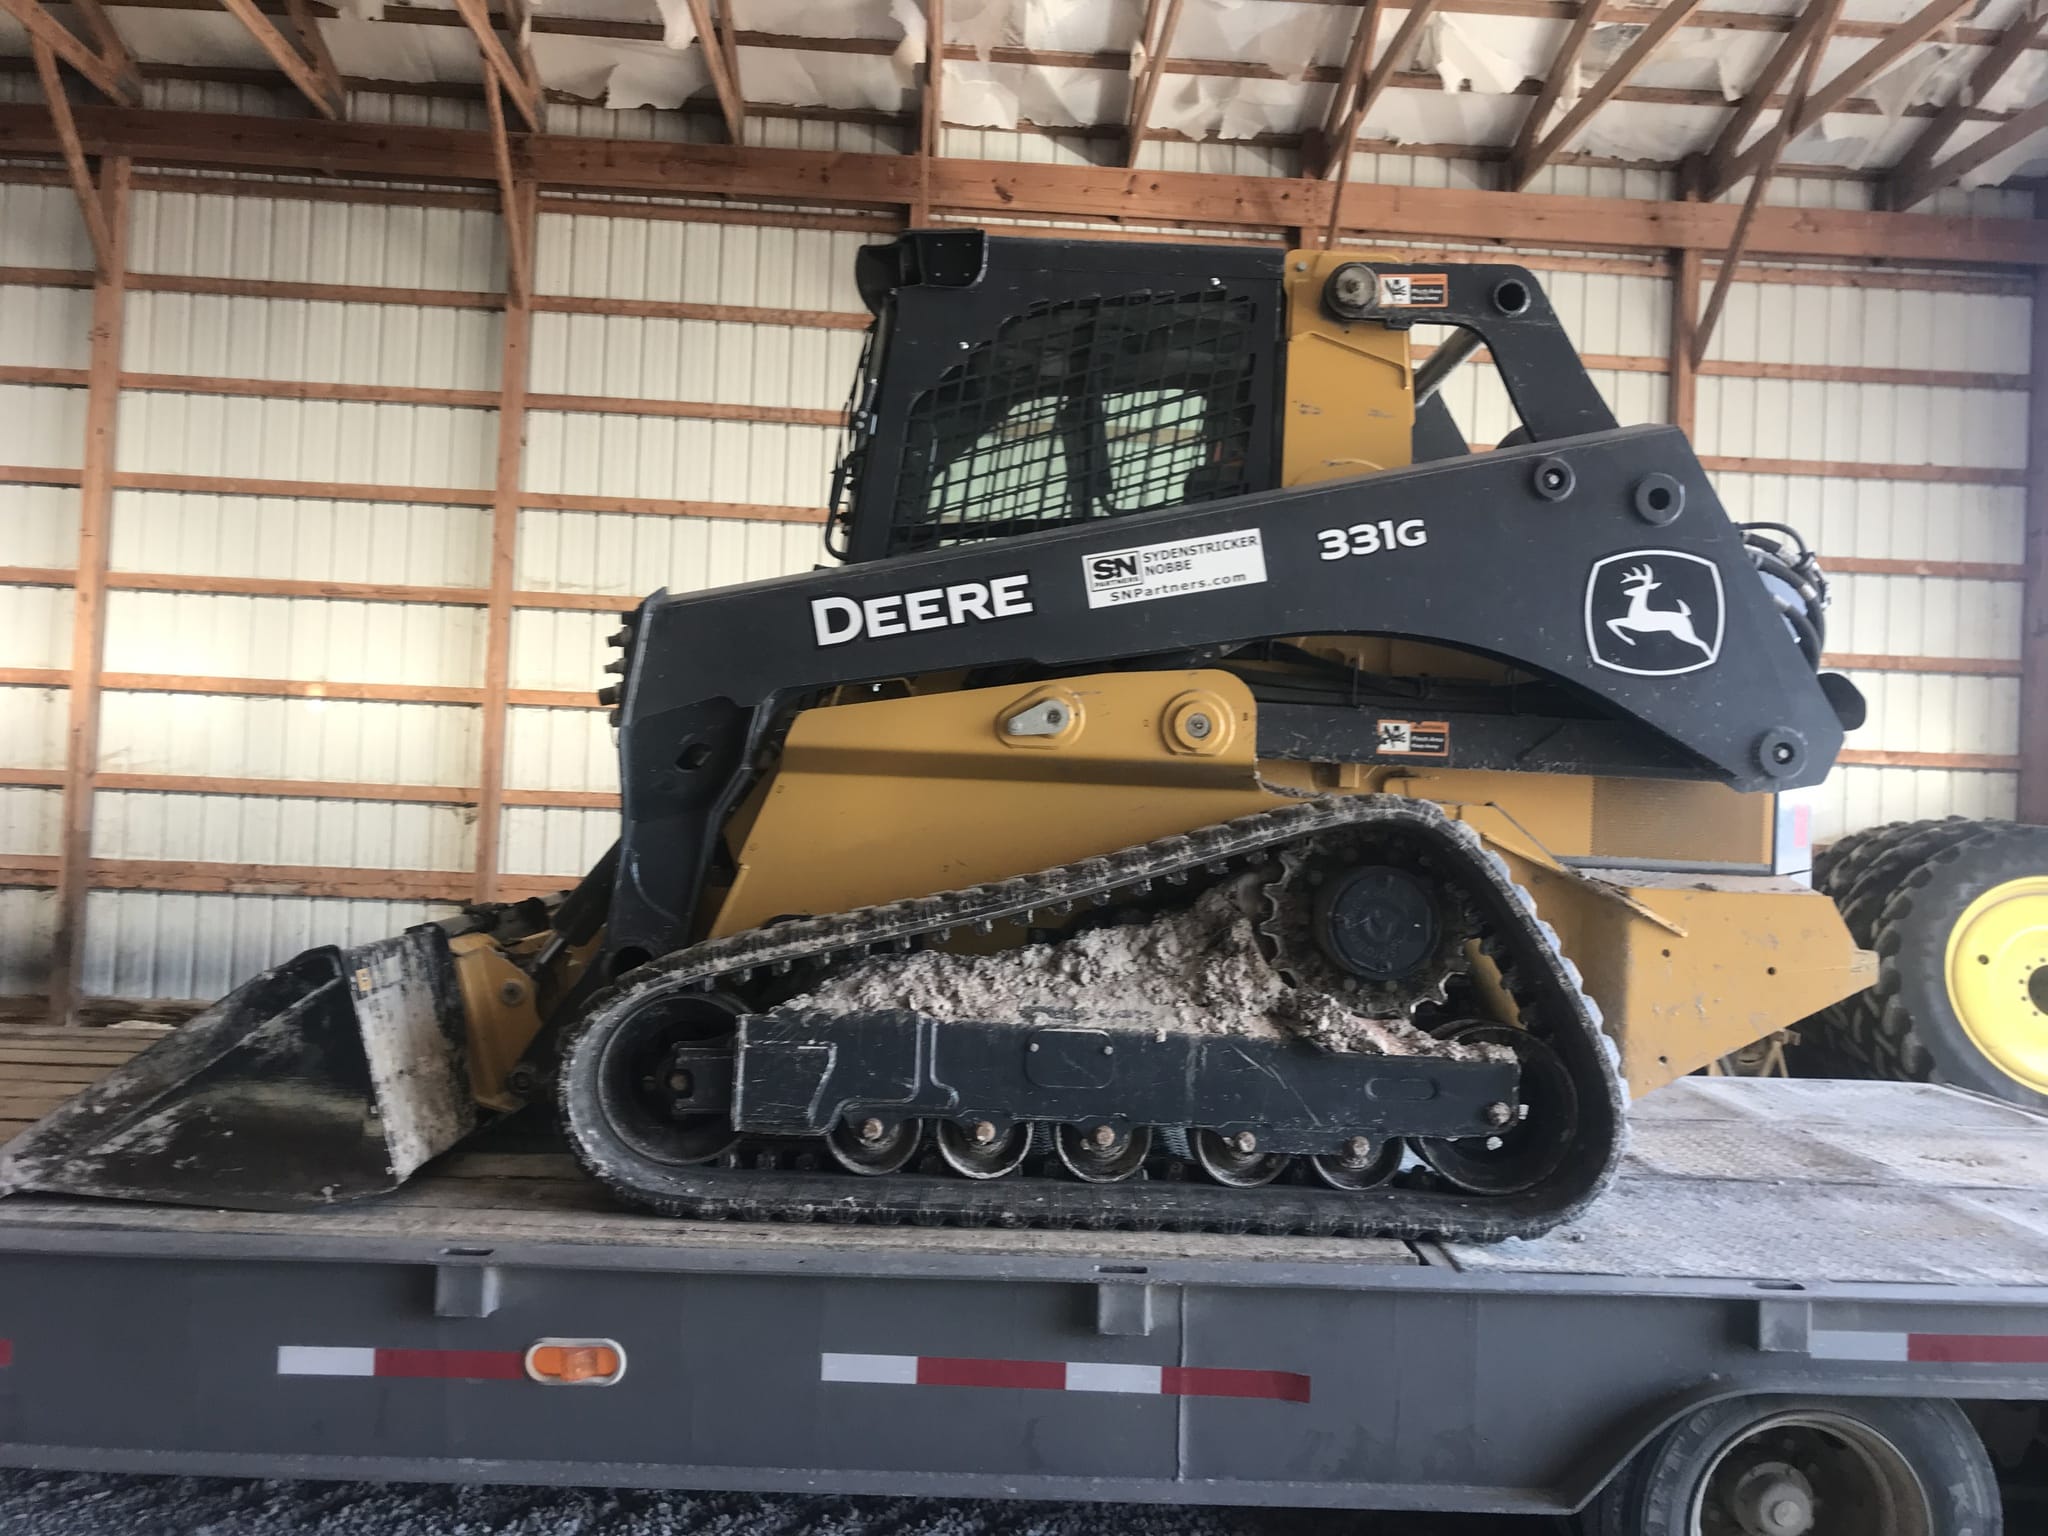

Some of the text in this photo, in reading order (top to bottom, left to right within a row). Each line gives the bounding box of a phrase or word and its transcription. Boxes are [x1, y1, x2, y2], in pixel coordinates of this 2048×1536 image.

[1143, 535, 1258, 563] SYDENSTRICKER
[1317, 519, 1427, 560] 331G
[1093, 555, 1137, 580] SN
[1145, 559, 1193, 576] NOBBE
[1111, 572, 1247, 602] SNPartners.com
[811, 574, 1034, 646] DEERE
